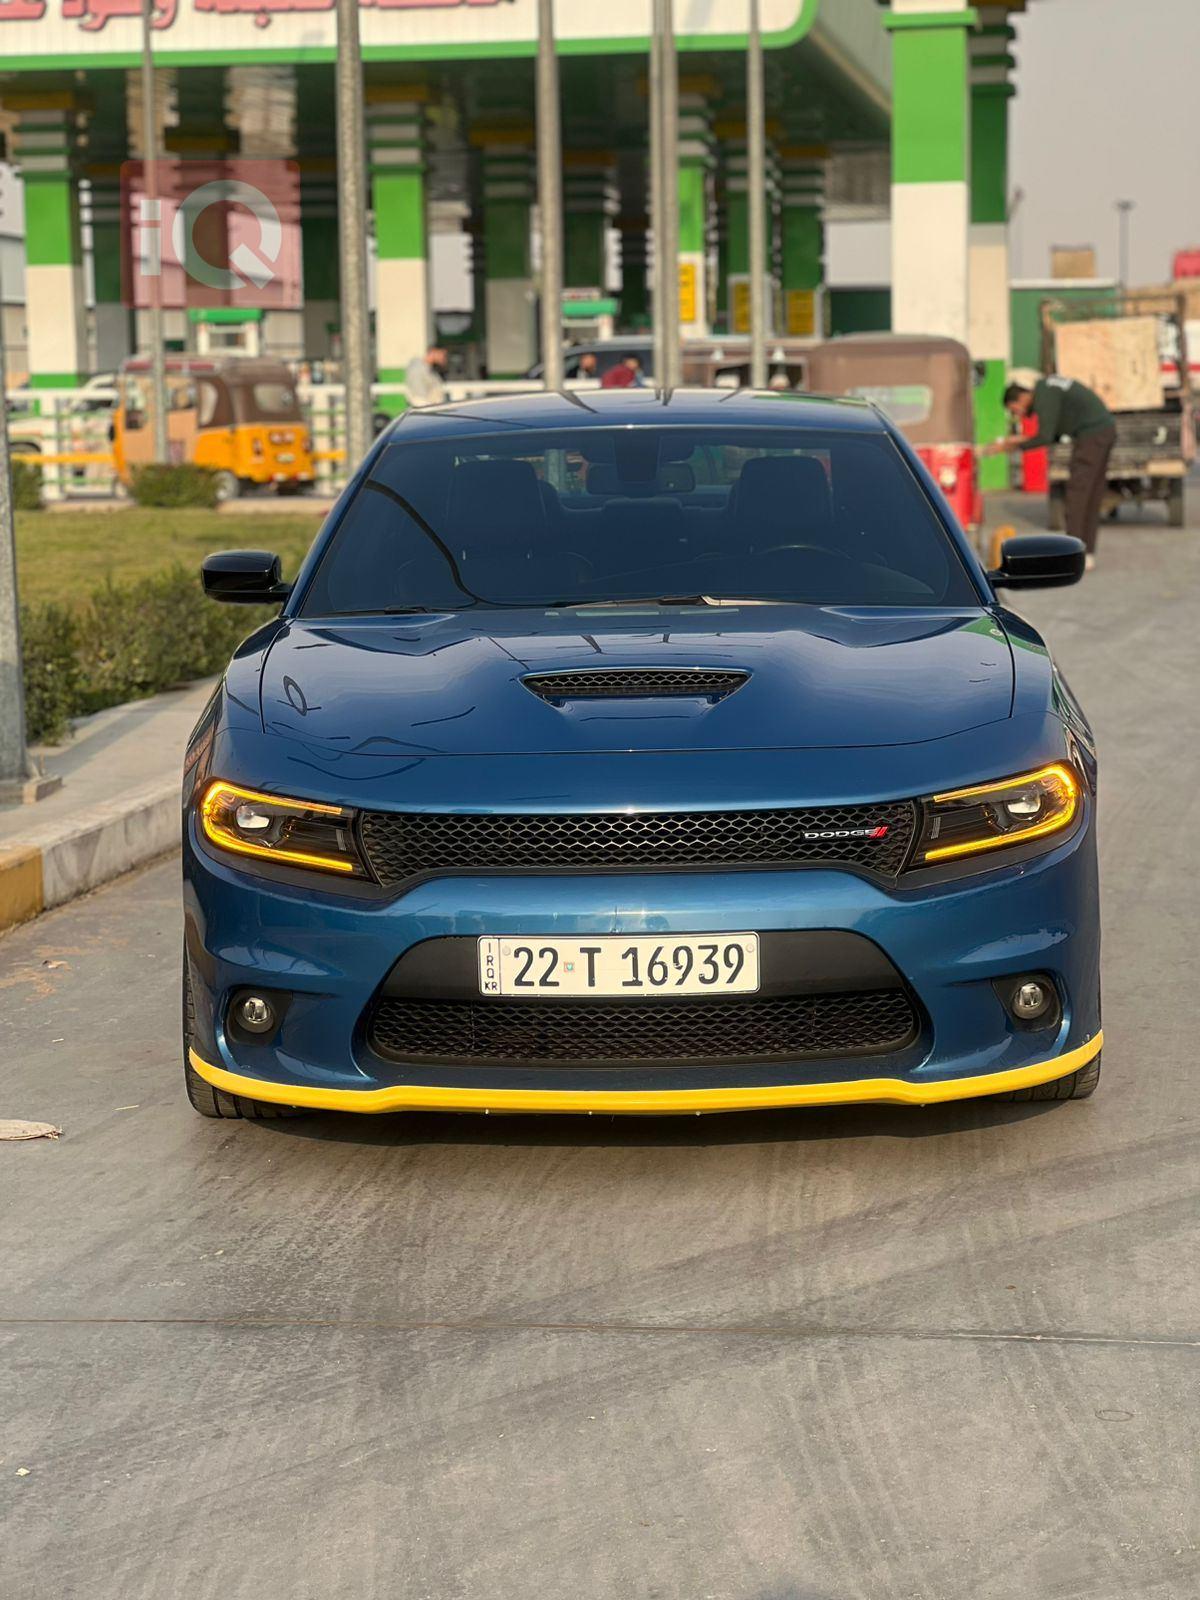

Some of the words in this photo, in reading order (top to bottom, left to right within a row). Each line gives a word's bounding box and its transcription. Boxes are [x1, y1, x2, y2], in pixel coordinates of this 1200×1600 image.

[804, 828, 877, 839] DODGE
[513, 946, 560, 987] 22
[579, 947, 602, 987] T
[621, 943, 745, 987] 16939
[484, 981, 498, 991] KR
